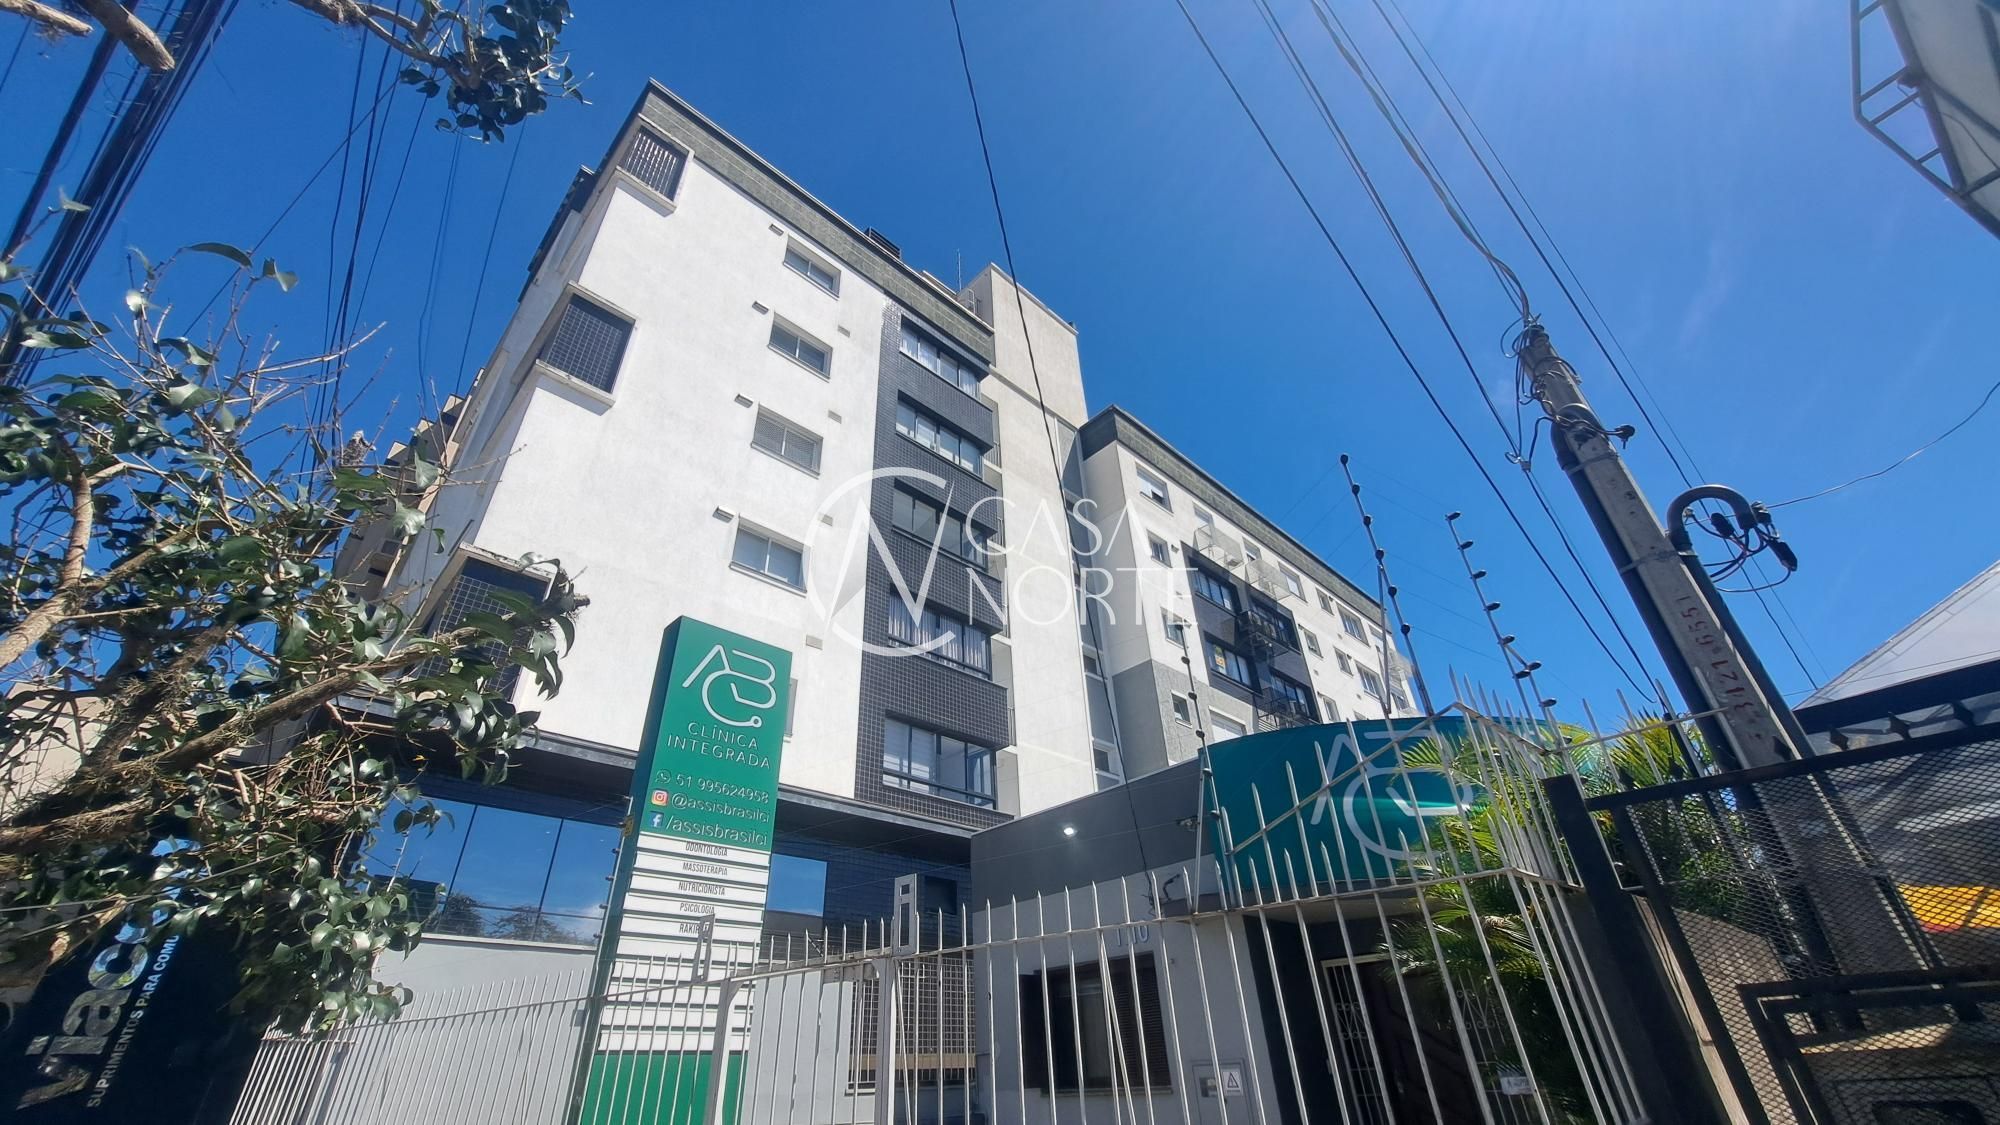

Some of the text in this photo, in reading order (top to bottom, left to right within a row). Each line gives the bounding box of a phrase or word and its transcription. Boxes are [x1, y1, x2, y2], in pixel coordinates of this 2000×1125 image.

[667, 735, 770, 769] INTEGRADA
[676, 773, 769, 804] 51 995624958
[671, 792, 770, 823] @assisbrasilci
[685, 841, 728, 857] ODONTOLOGIA
[682, 862, 728, 876] MASSOTERAPIA
[678, 881, 725, 895] NUTRICIONISTA
[679, 902, 715, 914] PSICOLOGIA
[87, 1009, 144, 1108] SUPRIMENTOS
[136, 973, 162, 1008] PARA
